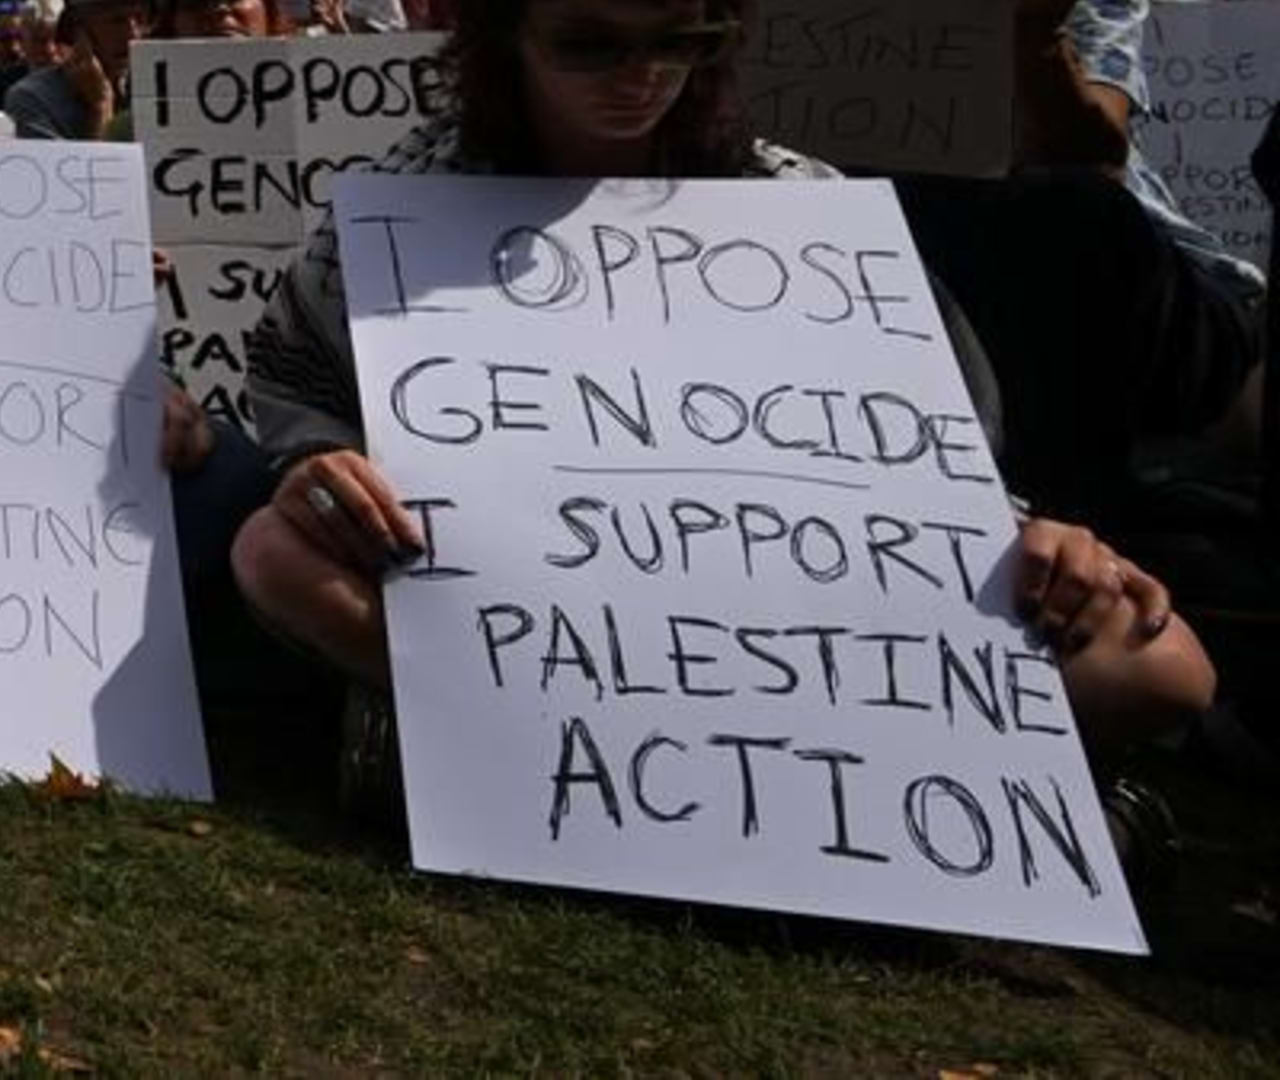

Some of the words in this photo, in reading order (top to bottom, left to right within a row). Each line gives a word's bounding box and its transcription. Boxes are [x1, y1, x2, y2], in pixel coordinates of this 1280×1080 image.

[154, 61, 170, 126] I
[197, 56, 443, 129] OPPOSE
[750, 5, 998, 72] ESTINE
[752, 78, 958, 155] TION
[167, 264, 188, 320] I
[350, 215, 470, 315] I
[489, 223, 933, 342] OPPOSE
[389, 356, 997, 486] GENOCIDE
[400, 498, 480, 581] I
[544, 495, 989, 603] SUPPORT
[476, 604, 1071, 738] PALESTINE
[549, 716, 1104, 900] ACTION
